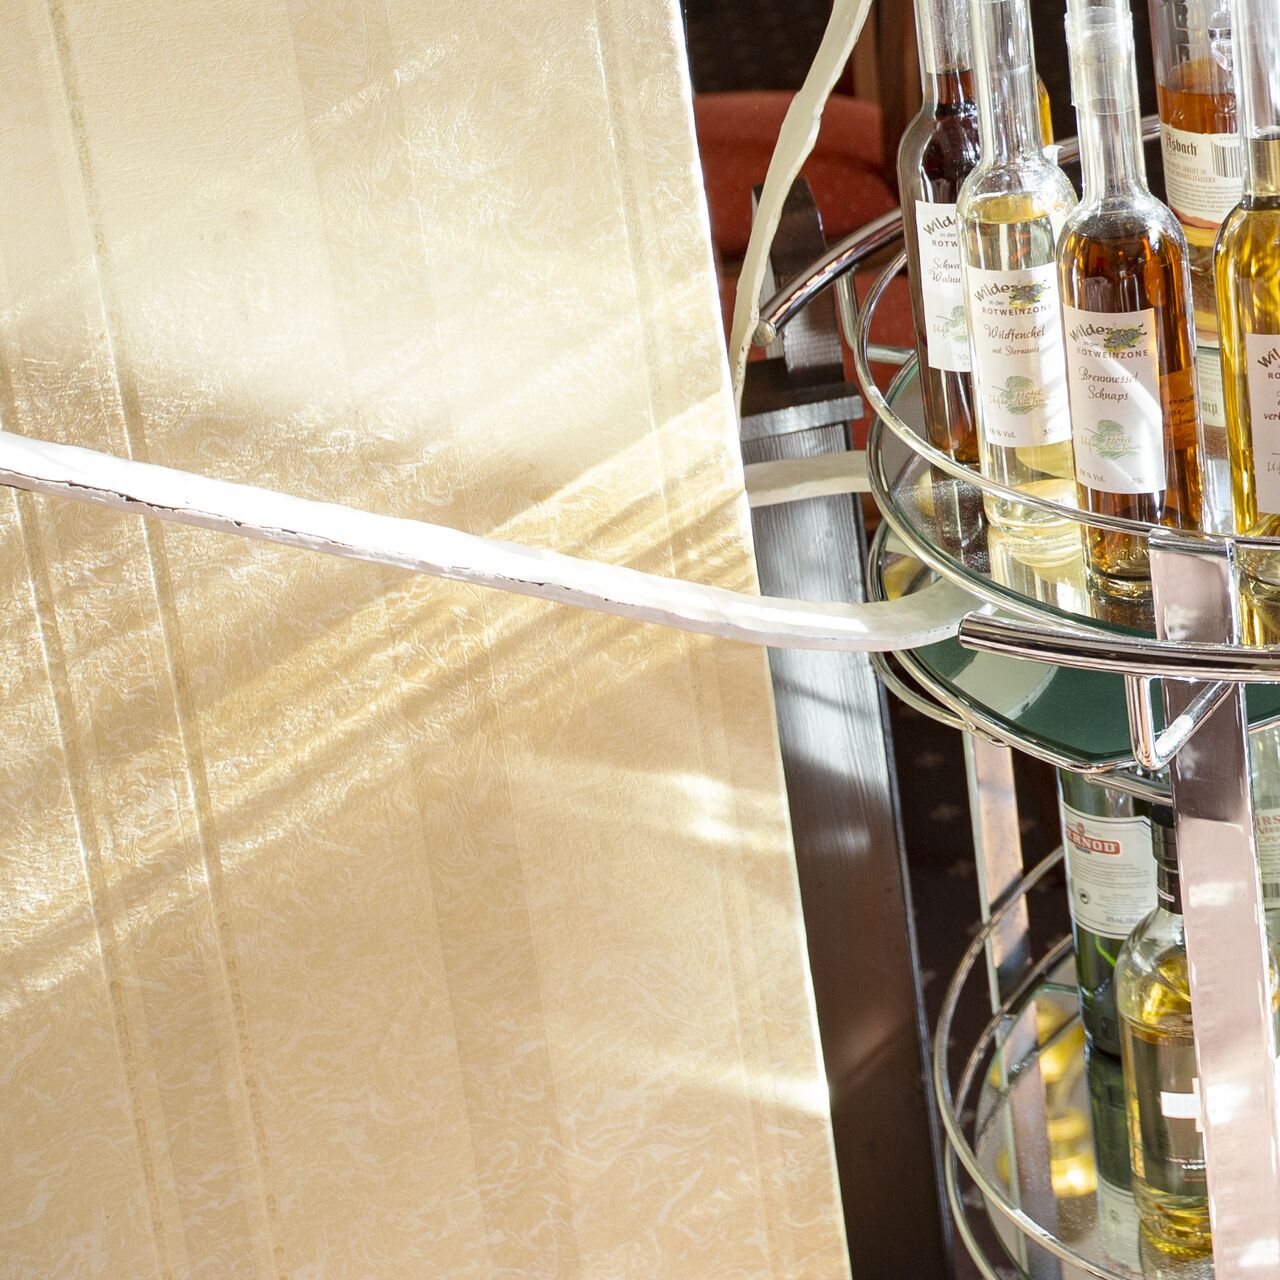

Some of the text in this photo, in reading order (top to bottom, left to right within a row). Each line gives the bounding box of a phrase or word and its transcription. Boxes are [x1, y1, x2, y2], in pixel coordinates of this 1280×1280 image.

[1165, 131, 1197, 157] Asbach
[984, 324, 1045, 343] Wildfenchel
[1088, 384, 1129, 403] Schnaps
[1003, 430, 1017, 439] Vol.
[1093, 473, 1106, 483] Vol.
